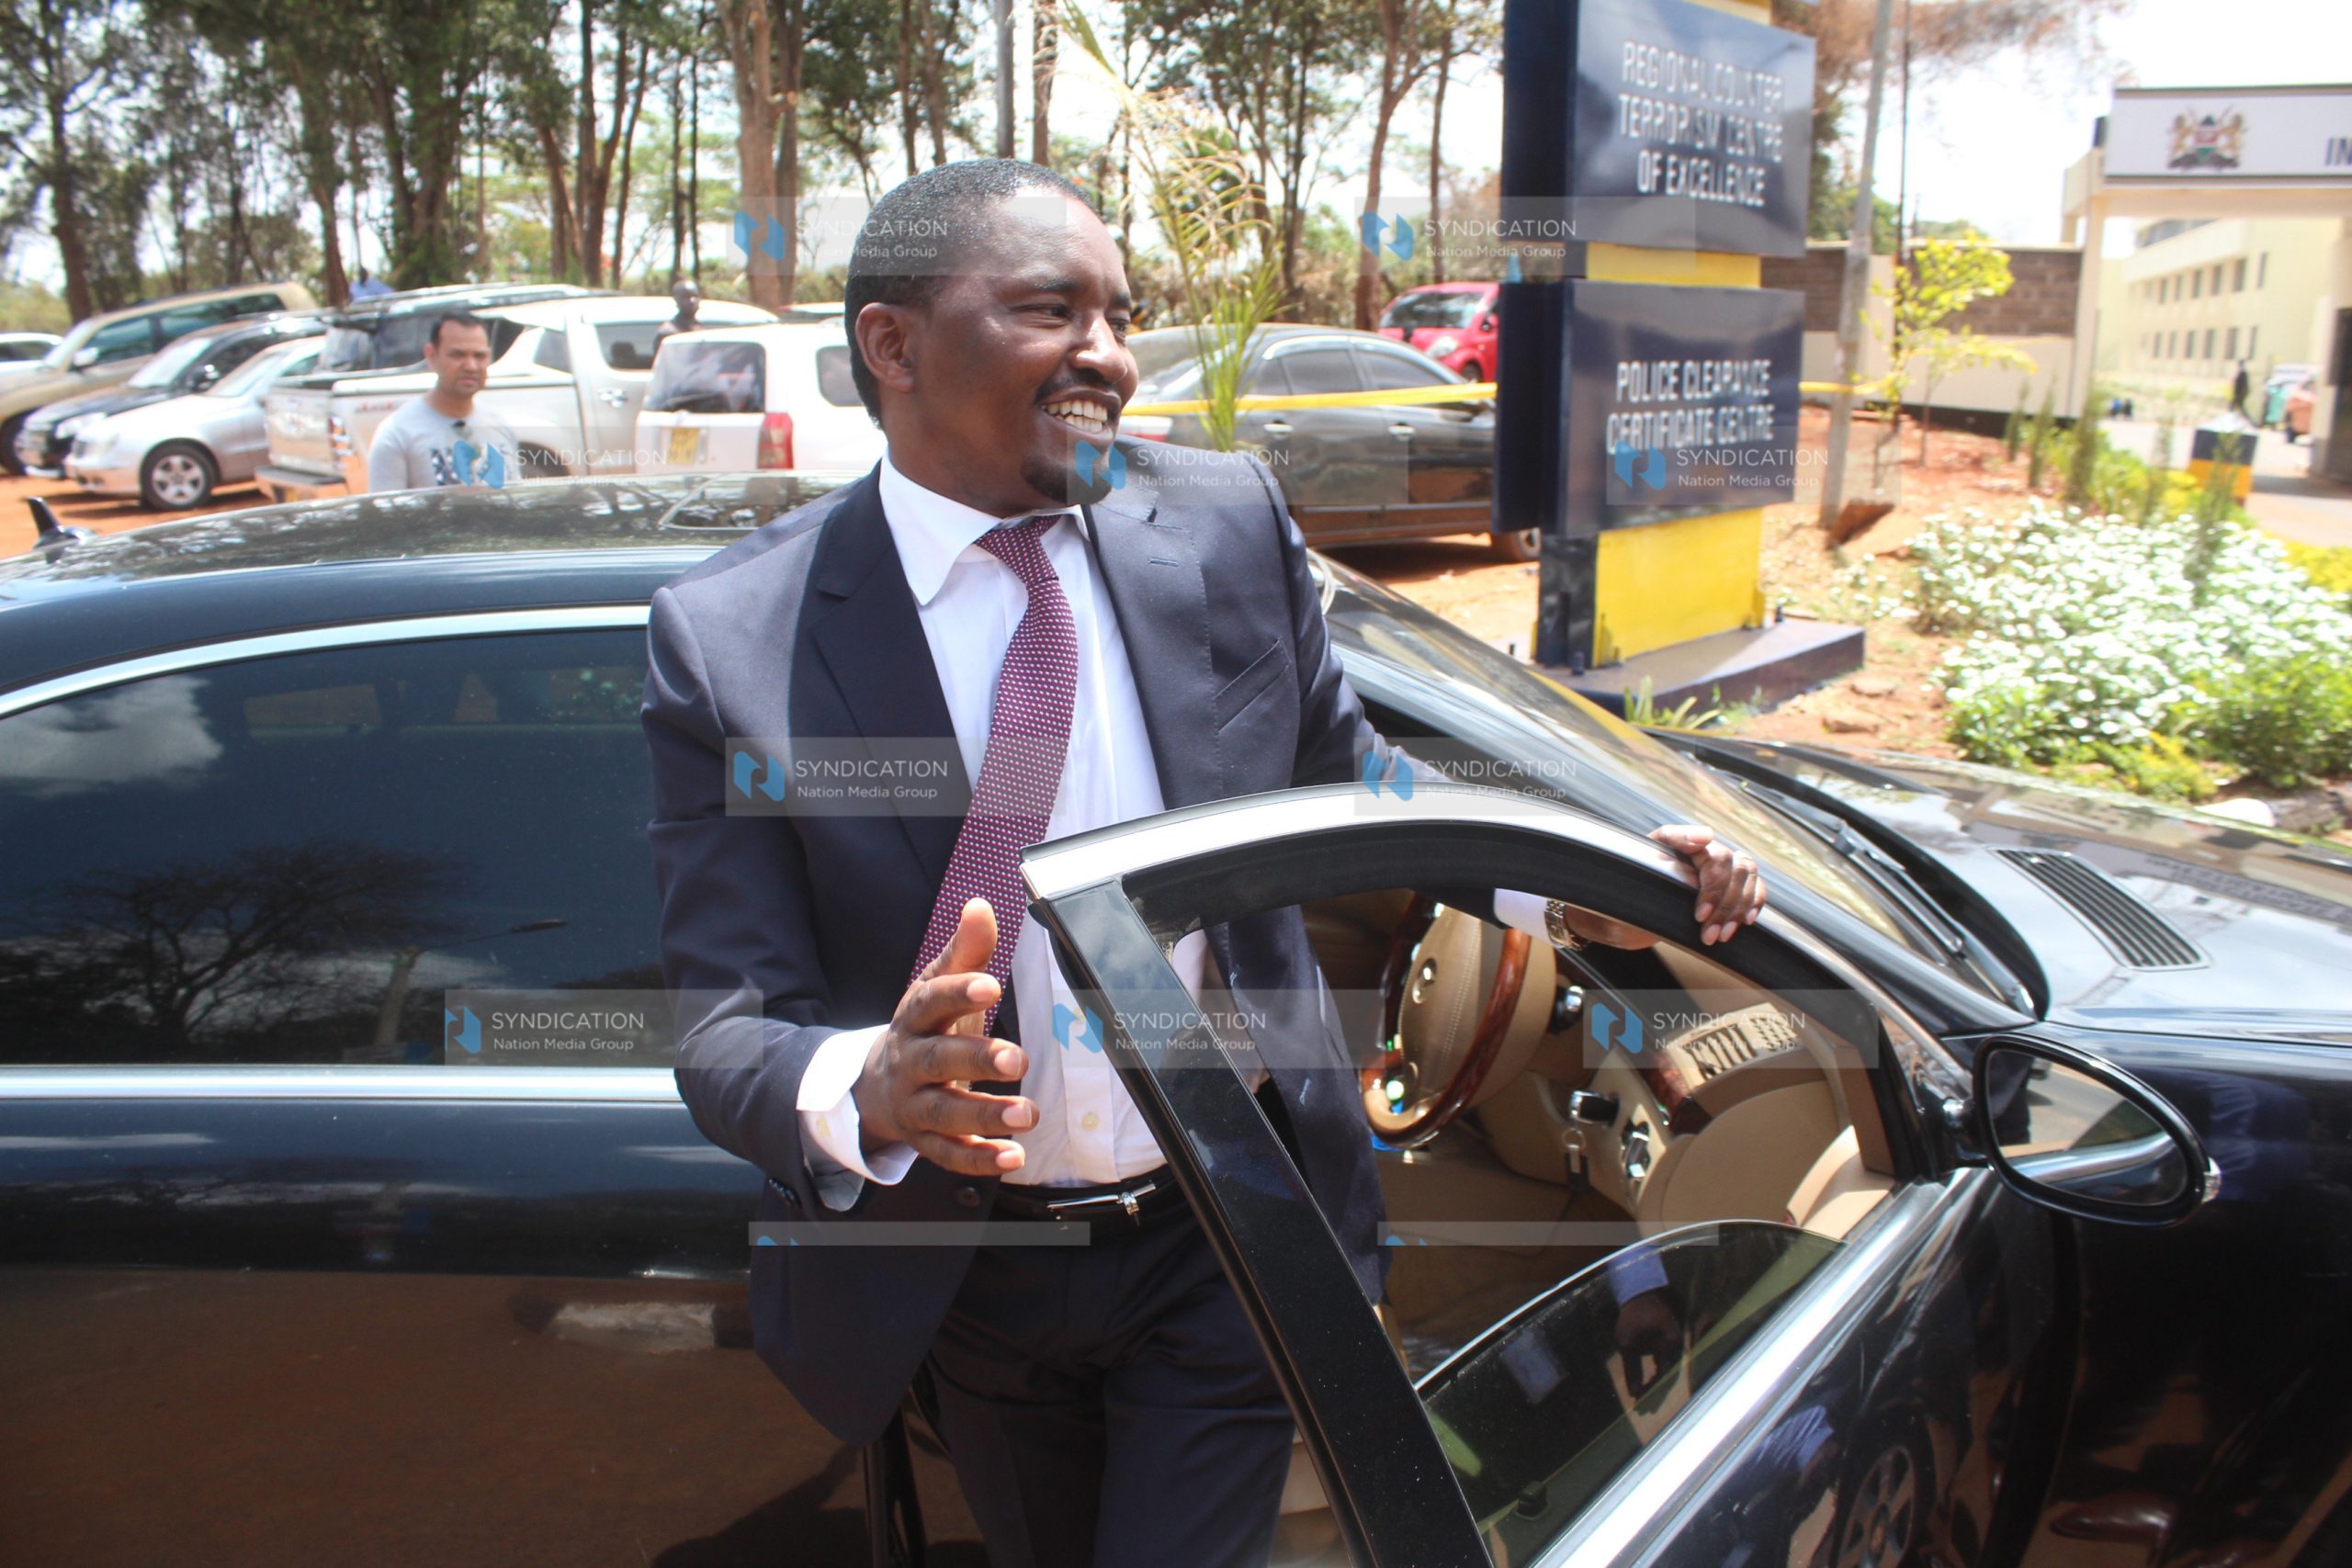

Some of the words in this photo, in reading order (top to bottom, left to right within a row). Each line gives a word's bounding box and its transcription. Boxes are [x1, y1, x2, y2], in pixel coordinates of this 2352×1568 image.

[1623, 40, 1708, 99] REGIONAL
[1618, 93, 1722, 150] TERRORISM
[1637, 149, 1662, 193] OF
[1665, 153, 1766, 208] EXCELLENCE
[1616, 359, 1679, 403] POLICE
[1682, 359, 1771, 400] CLEARANCE
[1606, 407, 1714, 455] CERTIFICATE
[1717, 403, 1775, 445] CENTRE
